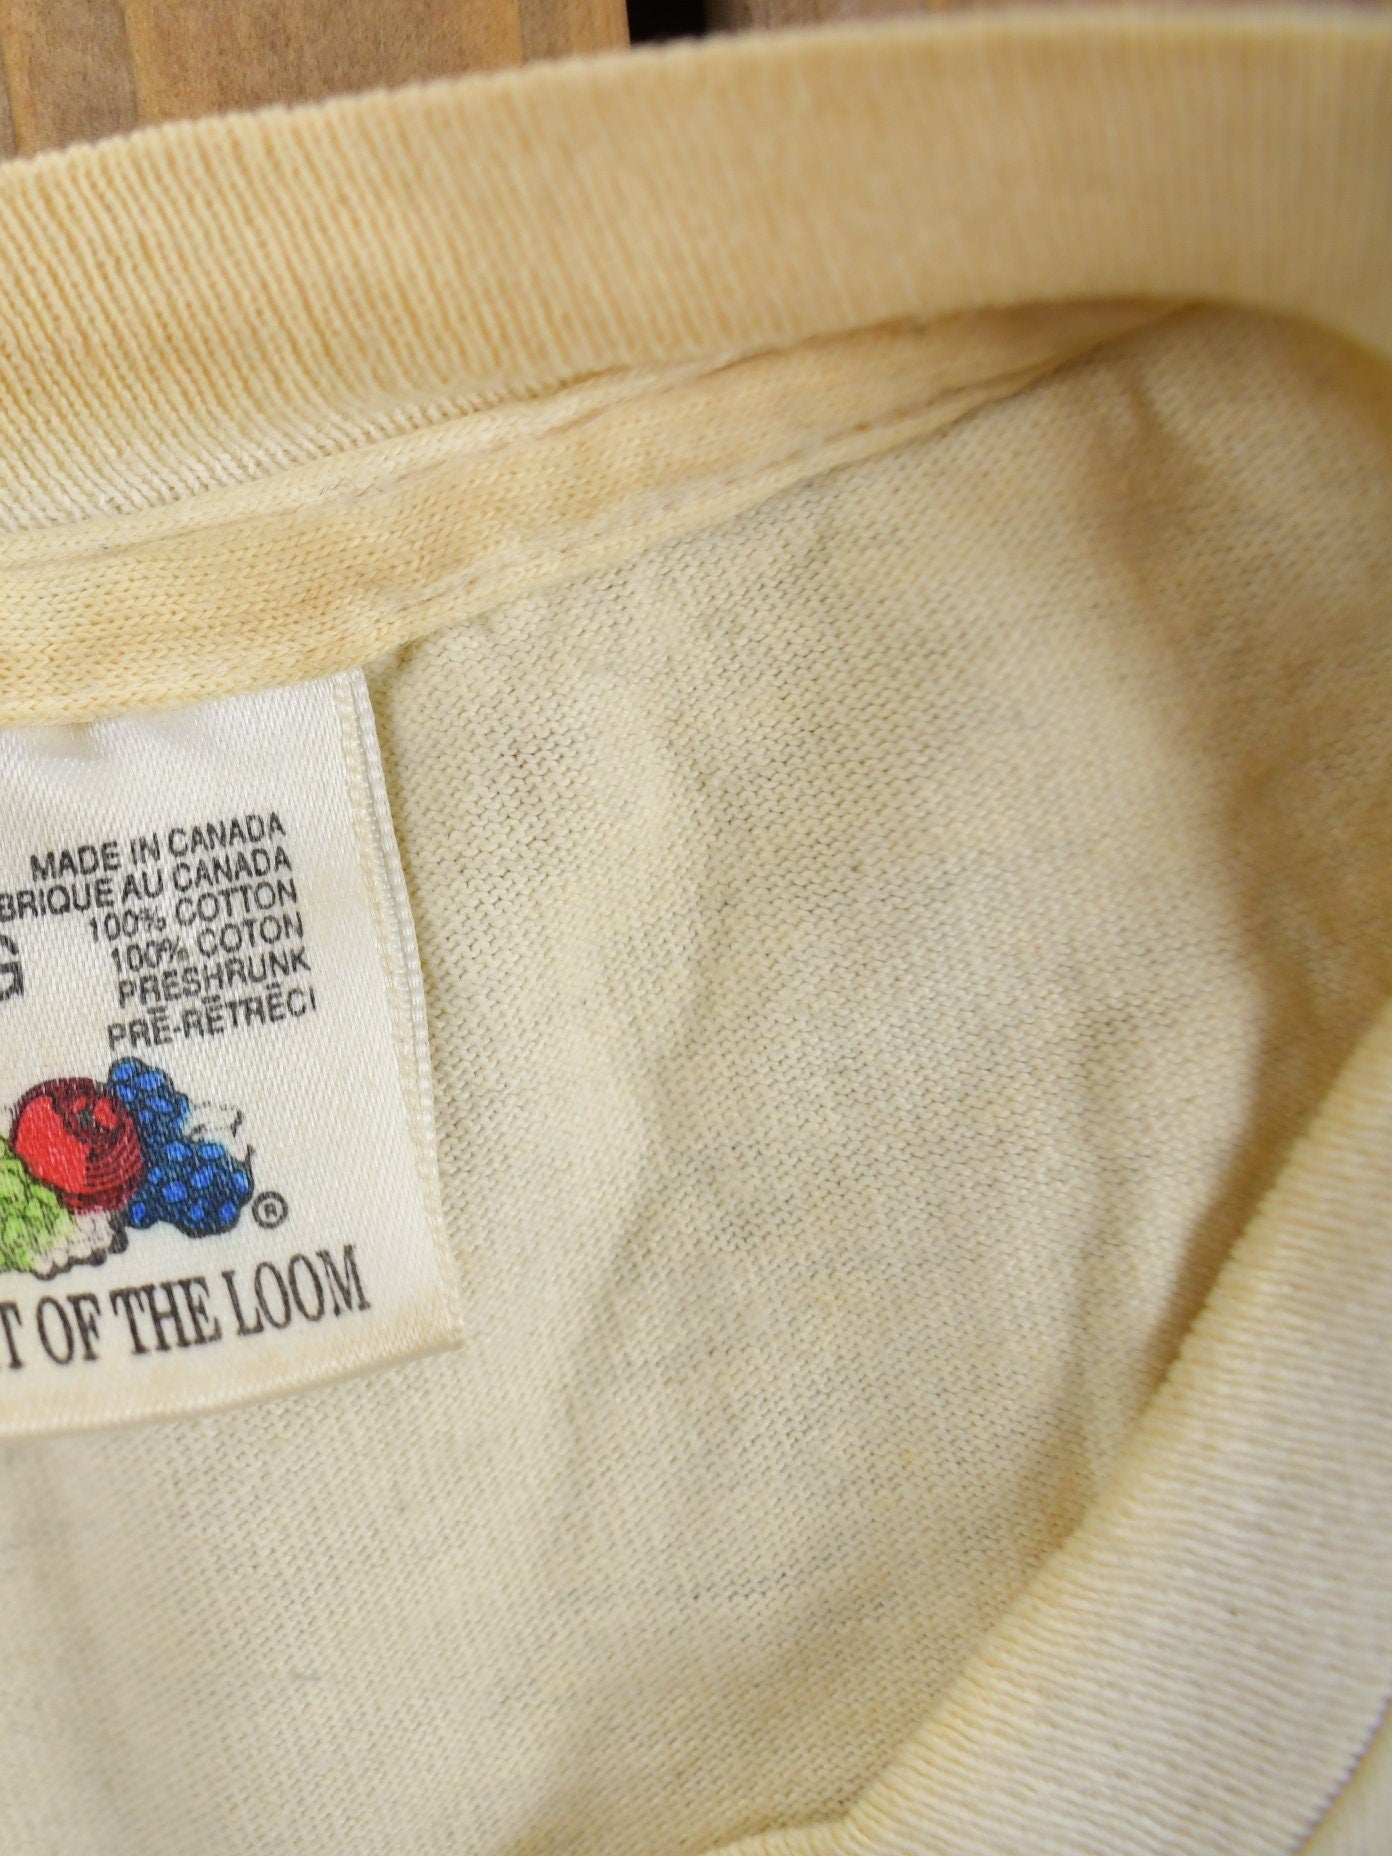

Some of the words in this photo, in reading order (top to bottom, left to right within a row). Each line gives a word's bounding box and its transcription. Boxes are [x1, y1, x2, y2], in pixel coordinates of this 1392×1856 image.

[30, 841, 120, 882] MADE
[129, 832, 161, 865] IN
[167, 811, 287, 856] CANADA
[121, 869, 164, 900] AU
[172, 845, 293, 893] CANADA
[89, 905, 167, 943] 100%
[175, 878, 298, 926] COTTON
[111, 935, 190, 974] 100%
[196, 912, 304, 958] COTON
[119, 946, 311, 1008] PRESHRUNK
[36, 1292, 103, 1365] OF
[111, 1277, 221, 1355] THE
[221, 1244, 371, 1335] LOOM
